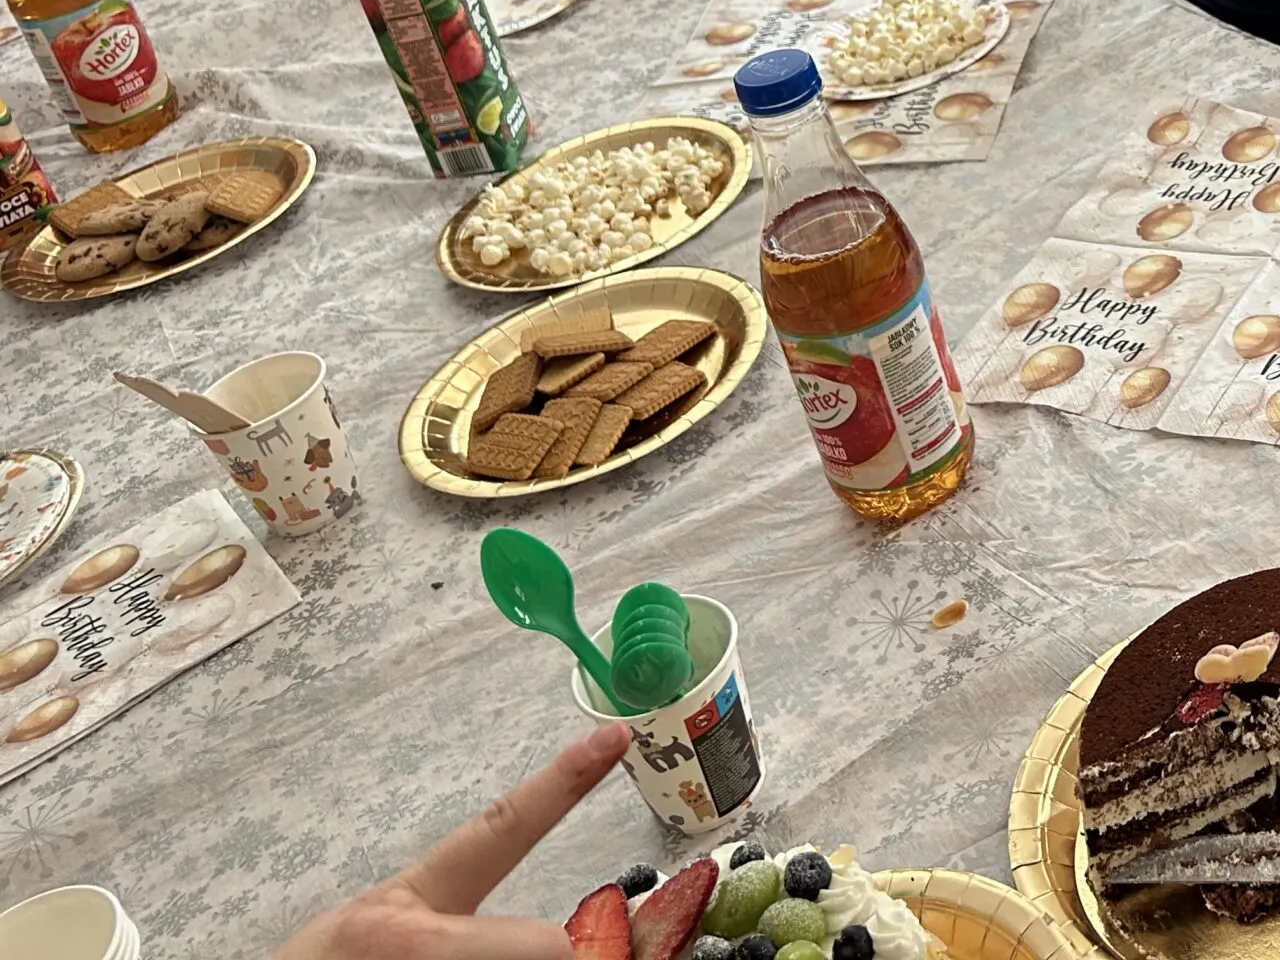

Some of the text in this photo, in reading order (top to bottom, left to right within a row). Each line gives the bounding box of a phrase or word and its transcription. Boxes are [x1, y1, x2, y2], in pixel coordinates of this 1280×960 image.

[86, 30, 136, 76] Hortex
[1167, 151, 1280, 186] Birthday
[1, 192, 29, 212] OCE
[1159, 183, 1251, 212] Happy
[1062, 287, 1162, 325] Happy
[889, 339, 904, 352] SOK
[1022, 317, 1149, 362] Birthday
[801, 389, 848, 413] ortex
[109, 567, 167, 637] Happy
[41, 595, 115, 682] Birthday
